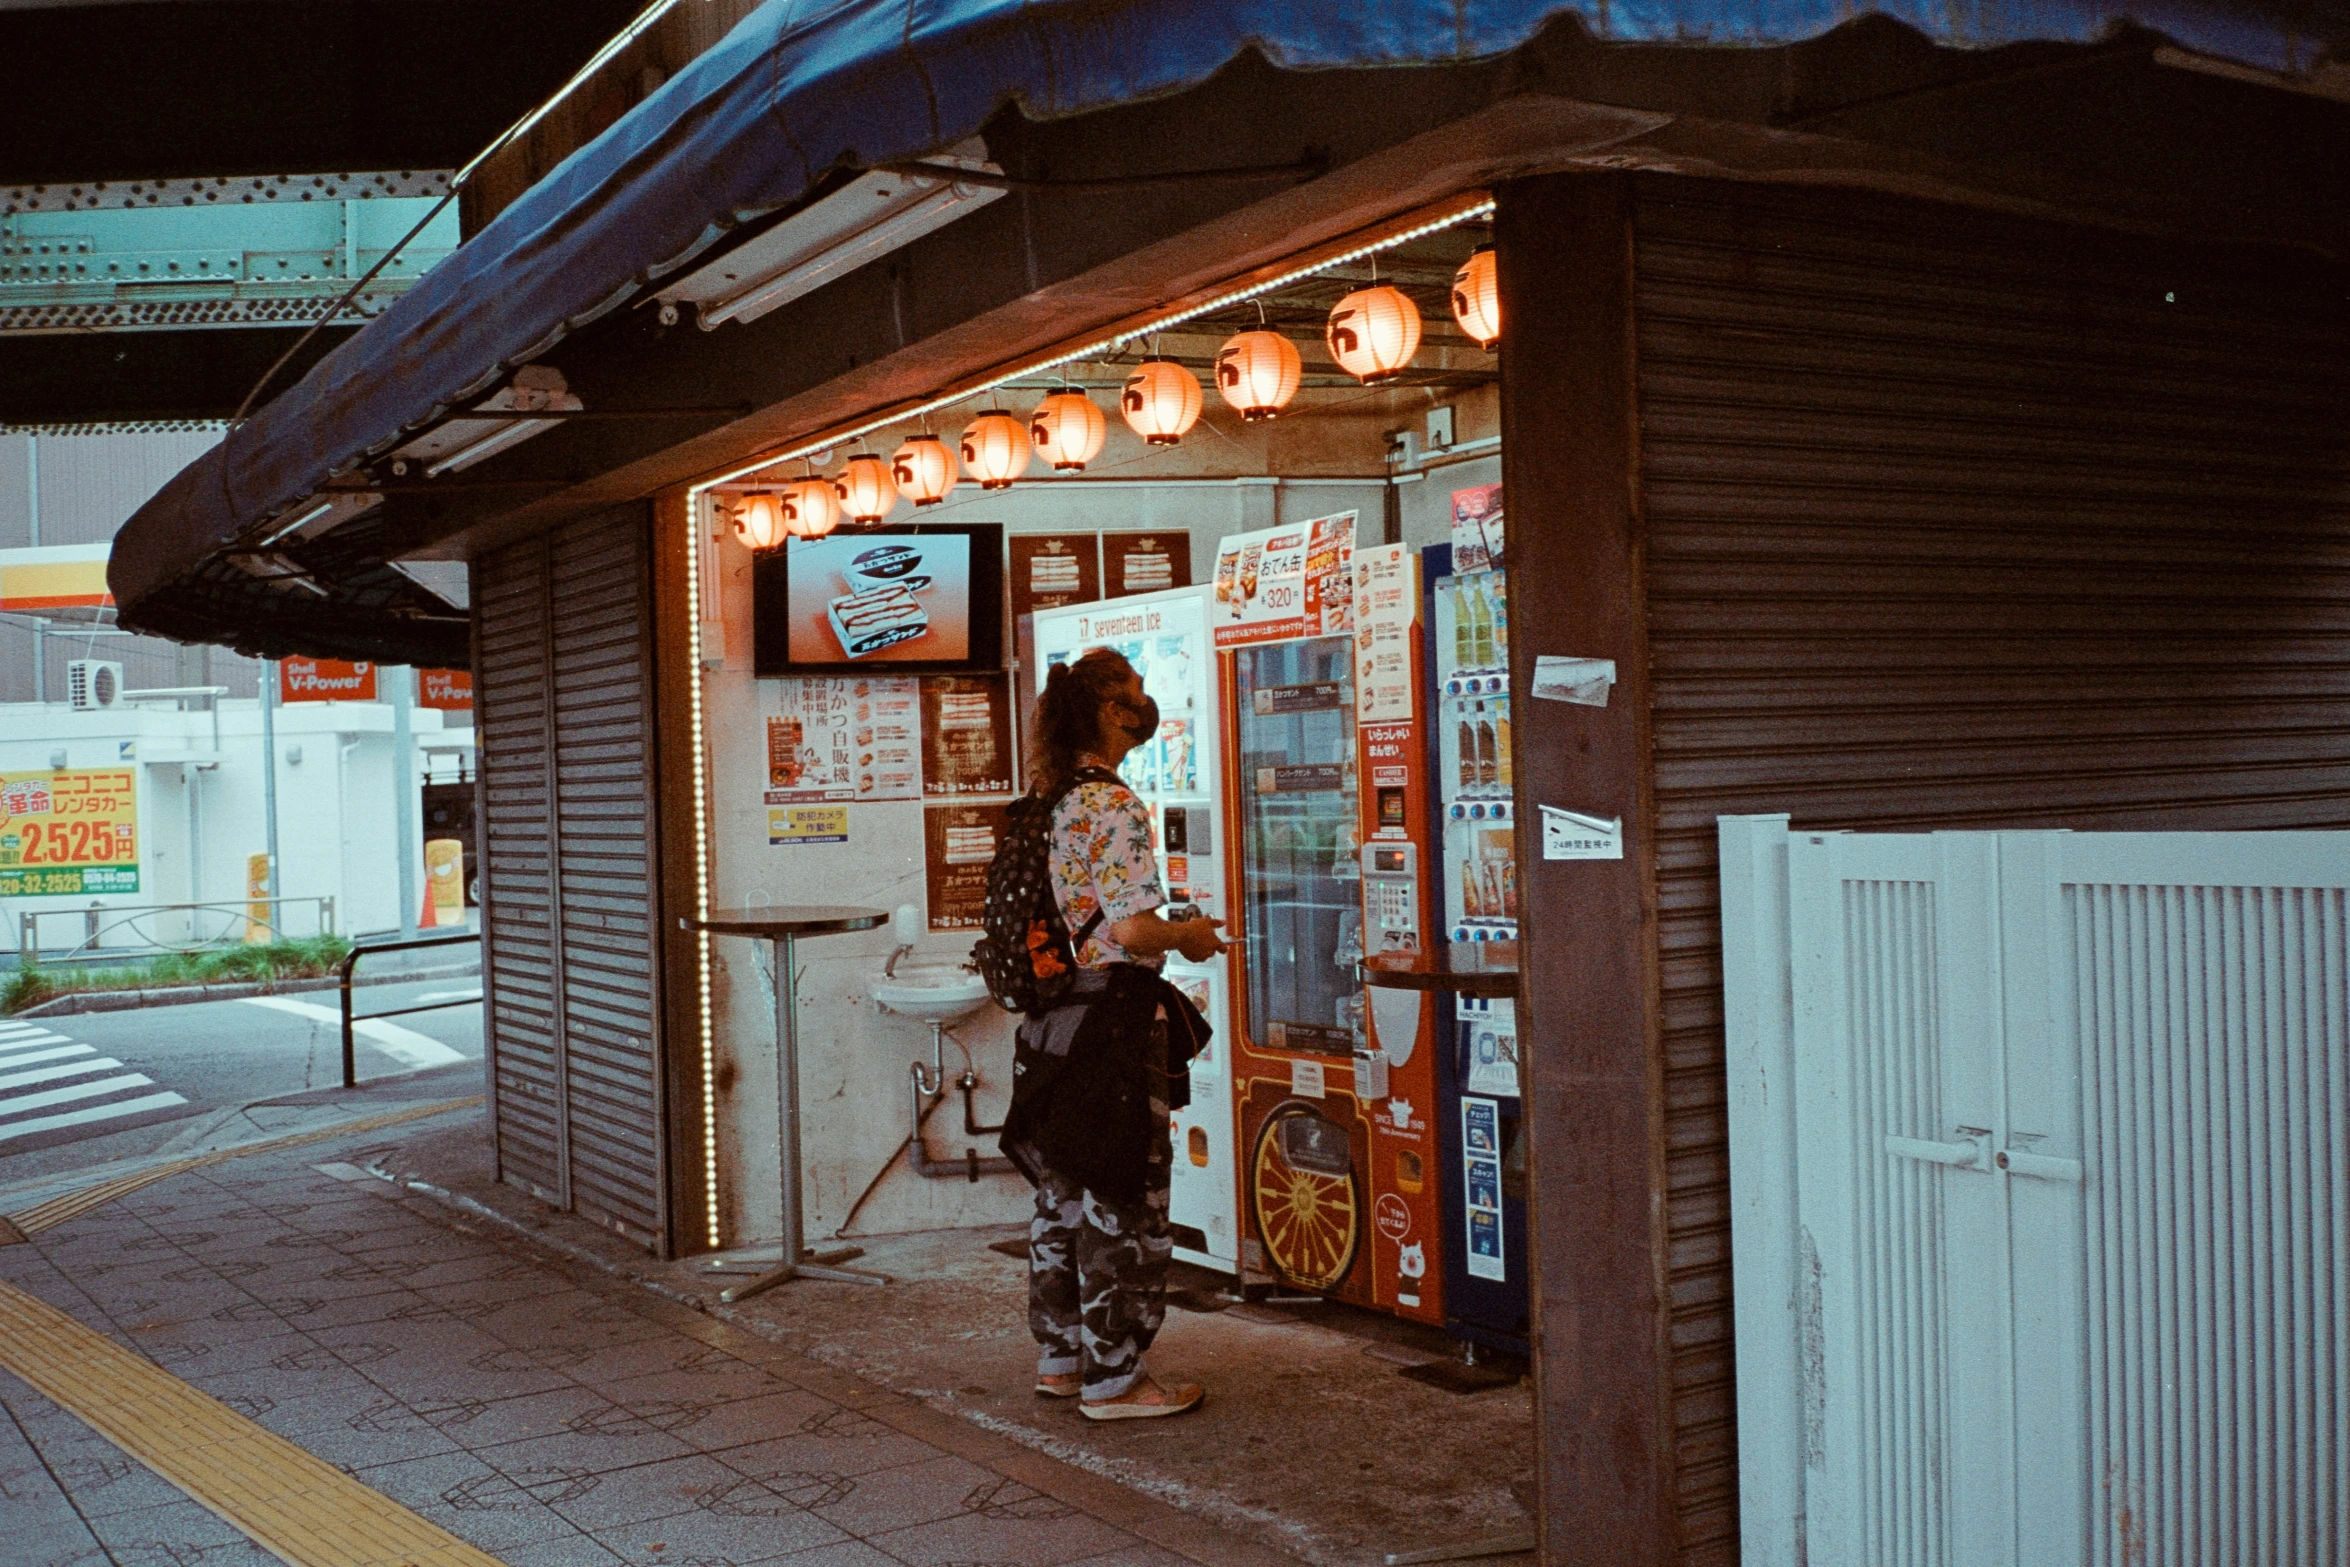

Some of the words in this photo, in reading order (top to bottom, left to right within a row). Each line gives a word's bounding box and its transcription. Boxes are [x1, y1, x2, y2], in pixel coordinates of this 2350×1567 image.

[1261, 554, 1302, 577] おでん缶
[1094, 614, 1144, 639] seventeen
[1146, 606, 1162, 631] ice
[288, 663, 316, 674] Shell
[289, 676, 362, 690] V-Power
[1367, 728, 1410, 741] いらっしゃい
[1369, 745, 1399, 757] まんせい
[53, 774, 131, 795] ニコニコ
[8, 791, 50, 815] 革命
[53, 797, 132, 815] レンタカー
[796, 811, 844, 821] 防犯カメラ
[807, 823, 835, 833] 作動中
[1553, 840, 1612, 850] 24時間監視中
[0, 873, 81, 894] 20-32-2525
[1375, 1114, 1392, 1125] SINCE
